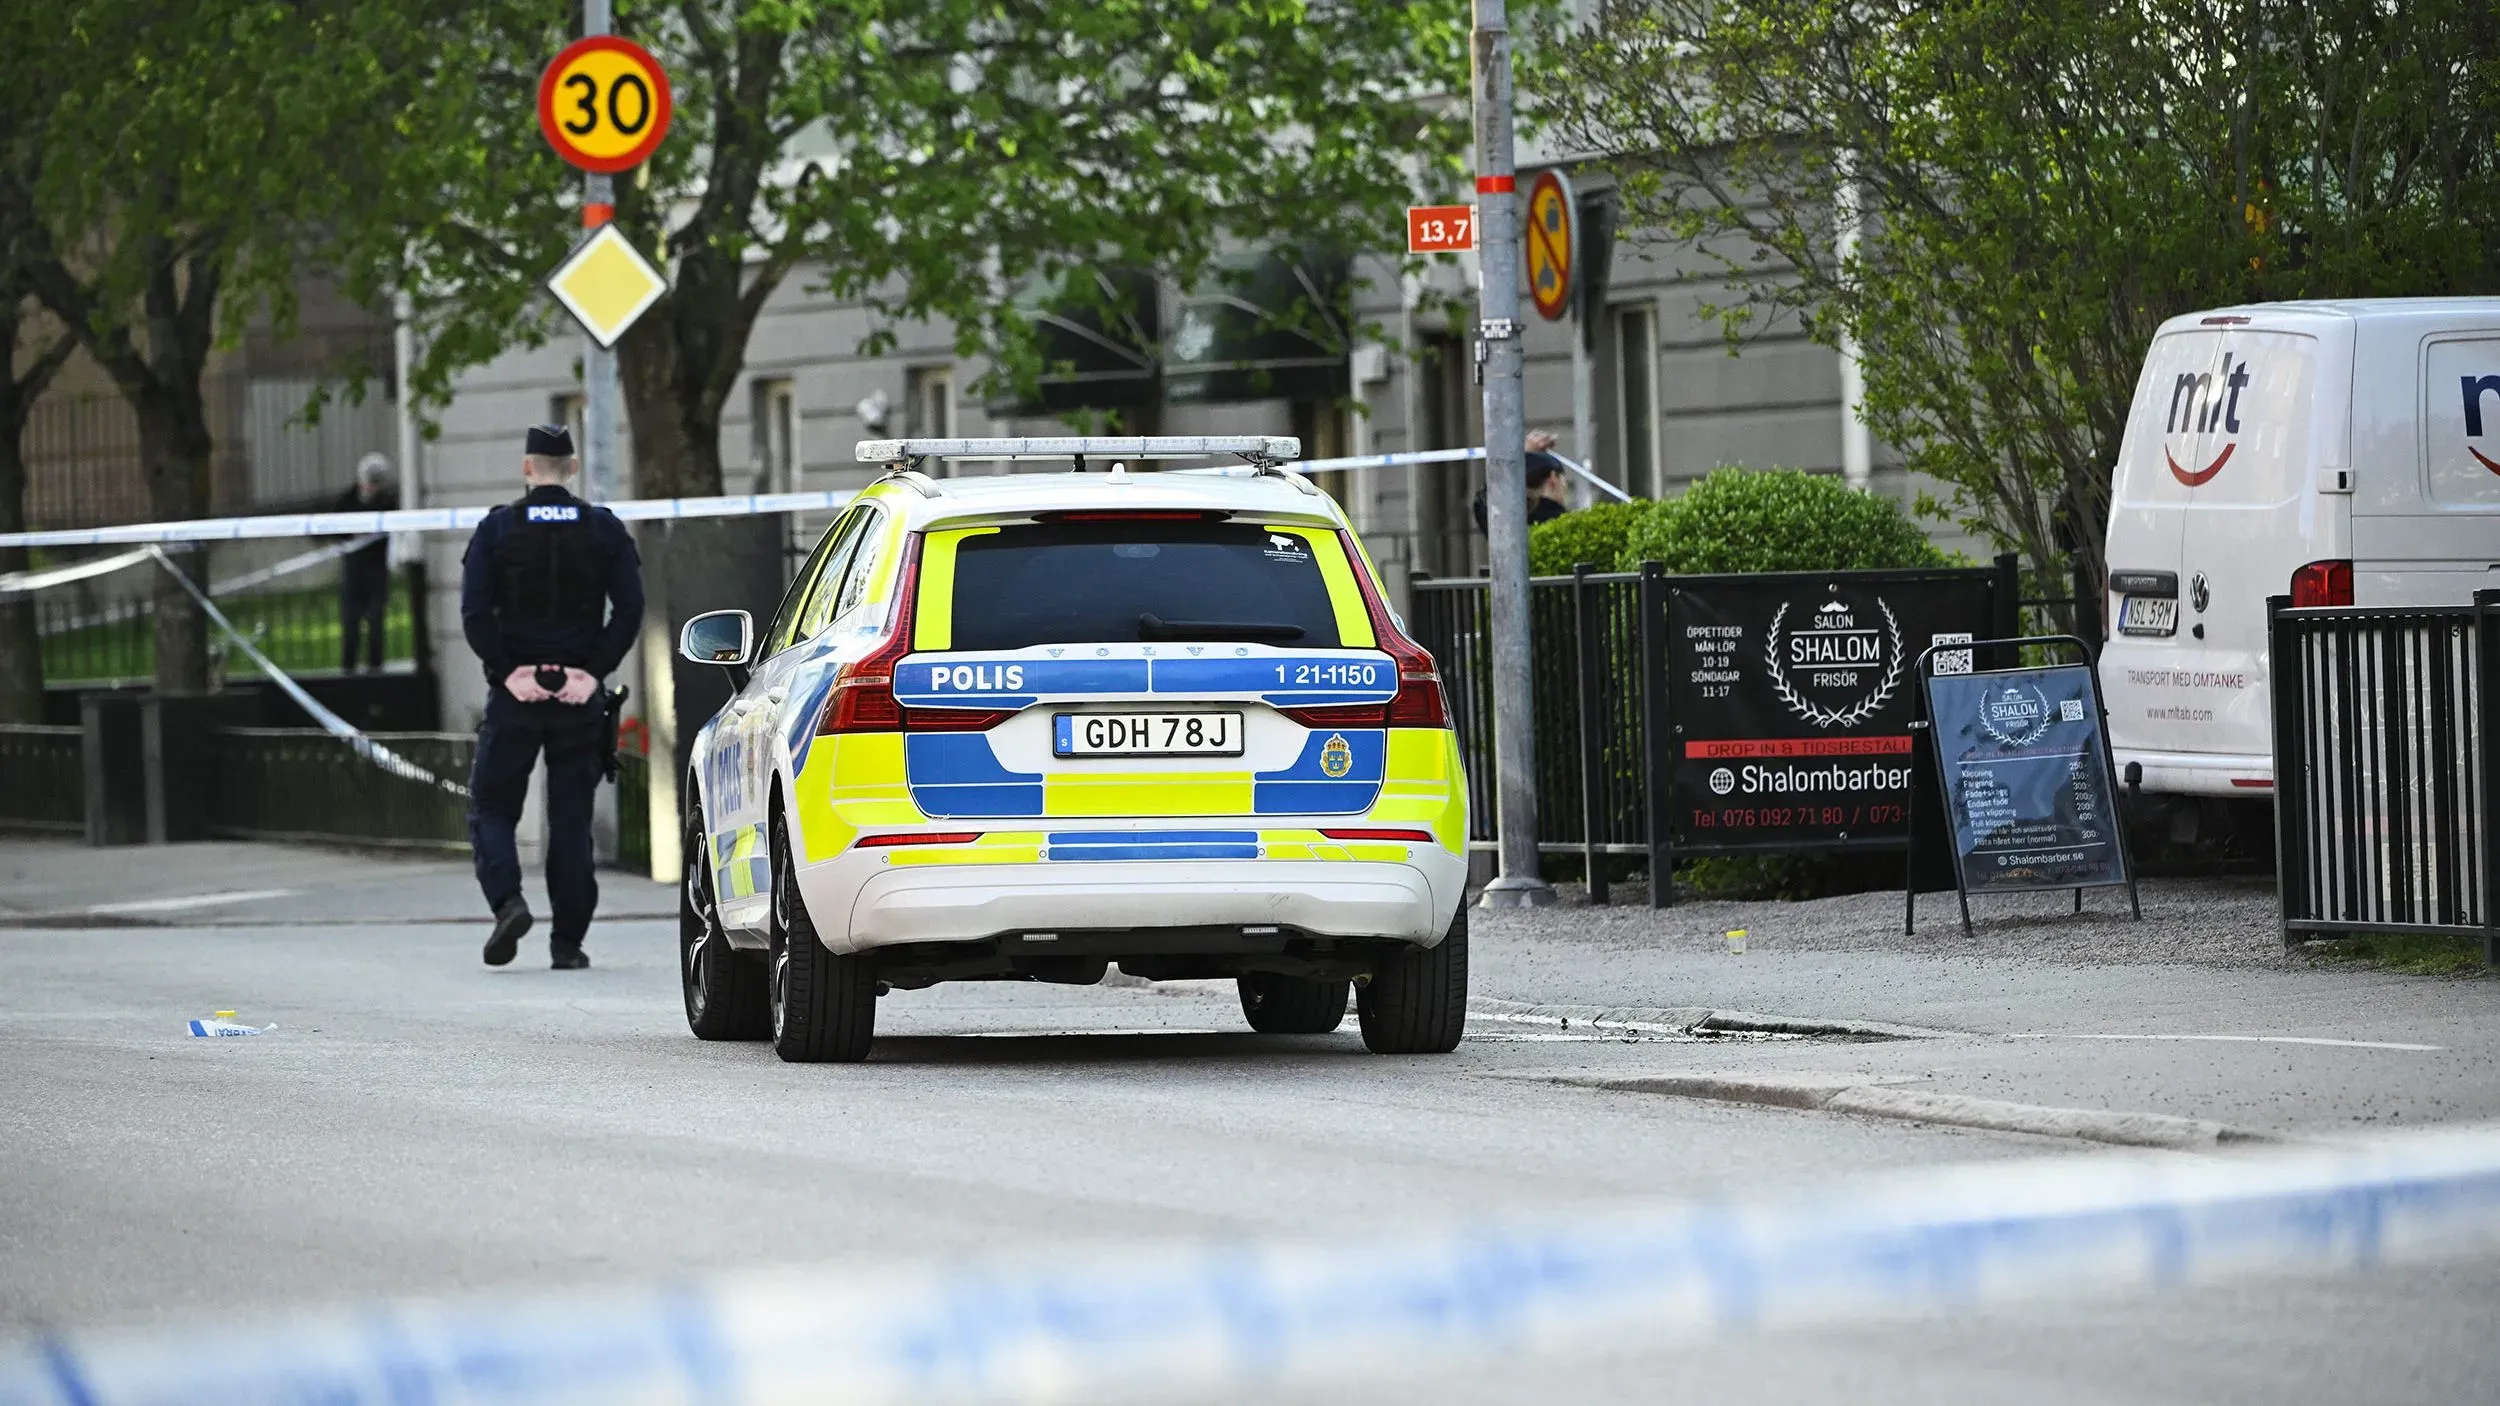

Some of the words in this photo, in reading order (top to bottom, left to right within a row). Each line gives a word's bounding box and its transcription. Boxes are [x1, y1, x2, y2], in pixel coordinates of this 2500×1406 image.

[564, 73, 650, 136] 30
[1420, 219, 1469, 246] 13,7
[2166, 352, 2250, 434] mlt
[527, 506, 578, 520] POLIS
[1814, 614, 1854, 629] SALON
[2127, 600, 2146, 625] NSL
[2149, 601, 2173, 627] 59M
[1686, 625, 1743, 638] ÖPPETTIDER
[1694, 640, 1736, 653] MÅN-LÖR
[1790, 636, 1880, 663] SHALOM
[1702, 656, 1730, 668] 10-19
[931, 665, 1024, 691] POLIS
[1275, 664, 1286, 684] 1
[1295, 664, 1376, 686] 21-1150
[1691, 669, 1740, 683] SÖNDAGAR
[1813, 670, 1858, 688] FRISÖR
[2127, 669, 2170, 687] TRANSPORT
[2172, 671, 2191, 687] MED
[2193, 672, 2245, 689] OMTANKE
[1702, 685, 1730, 697] 11-17
[2002, 693, 2023, 701] SALON
[1991, 703, 2039, 719] SHALOM
[2146, 706, 2213, 722] www.mltab.com
[1085, 718, 1150, 749] GDH
[1161, 717, 1227, 748] 78J
[1061, 738, 1068, 747] S
[1707, 743, 1755, 757] DROP
[1760, 742, 1775, 755] IN
[1781, 742, 1793, 755] &
[1724, 808, 1756, 828] 076
[1760, 808, 1792, 827] 092
[1797, 806, 1817, 826] 71
[1821, 806, 1844, 825] 80
[2009, 852, 2085, 866] Shalombarber.se
